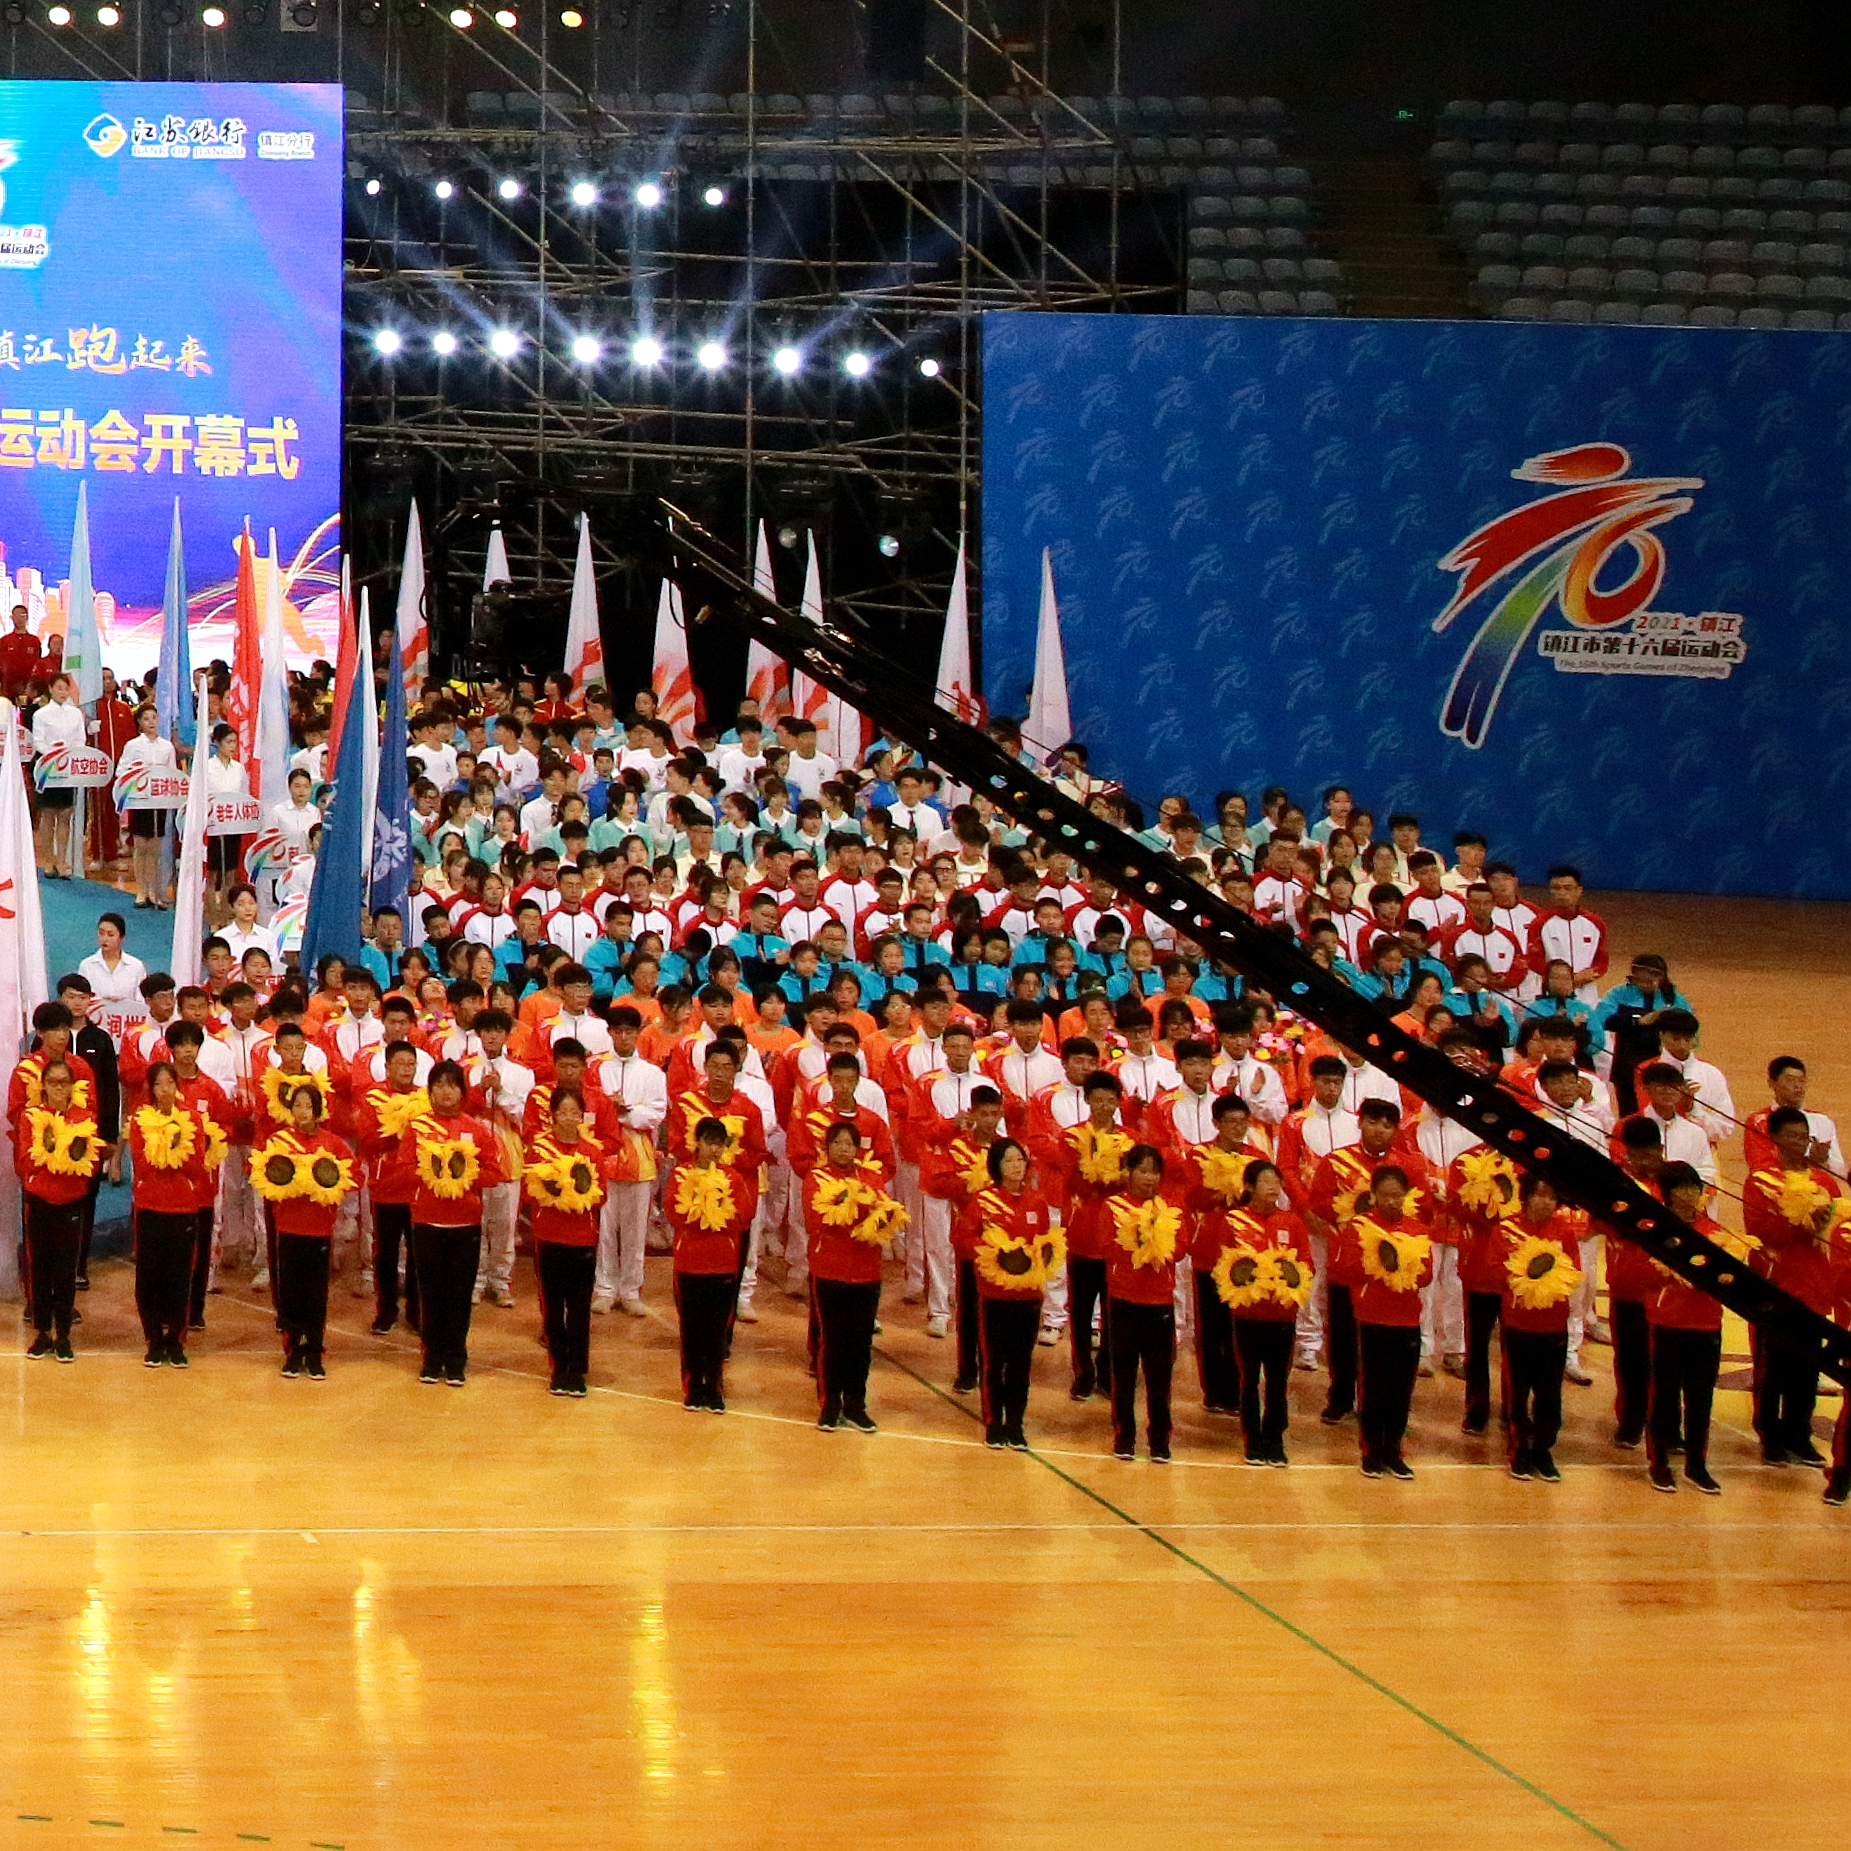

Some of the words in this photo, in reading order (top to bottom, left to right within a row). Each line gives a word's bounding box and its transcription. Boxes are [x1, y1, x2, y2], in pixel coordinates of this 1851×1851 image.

[134, 117, 245, 144] 江苏银行
[1544, 634, 1740, 658] 镇江市第十六届运动会
[70, 757, 108, 775] 航空协会
